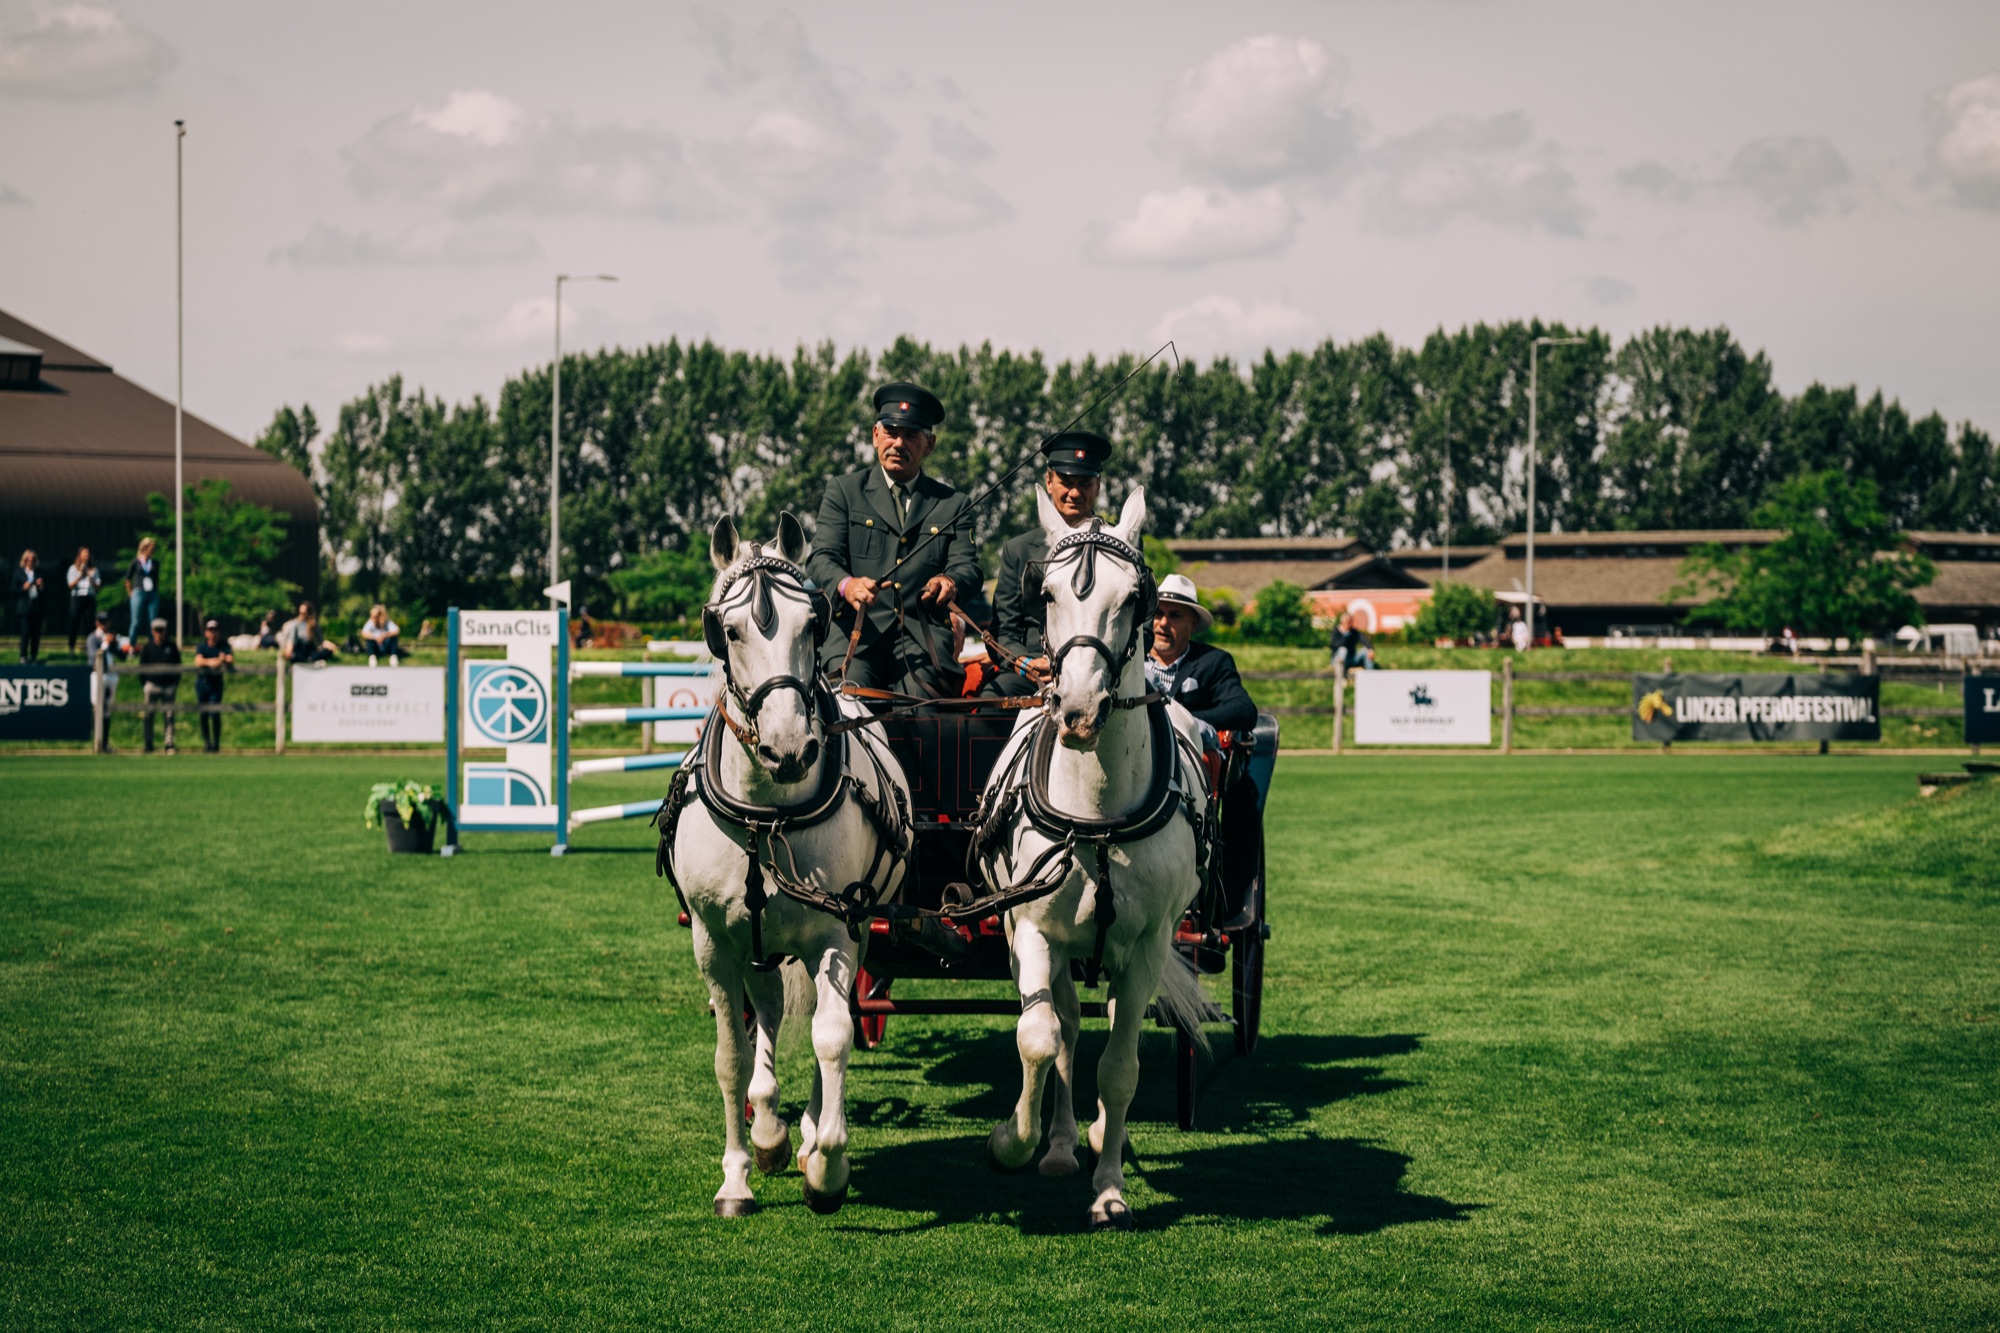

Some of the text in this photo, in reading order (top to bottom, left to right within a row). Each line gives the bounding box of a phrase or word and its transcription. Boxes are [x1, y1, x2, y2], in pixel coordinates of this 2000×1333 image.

[465, 618, 552, 636] SanaClis
[0, 678, 69, 707] NES
[1983, 688, 2000, 712] L
[306, 701, 431, 715] WEALTH EFFECT
[1676, 696, 1877, 723] LINZER PFERDEFESTIVAL
